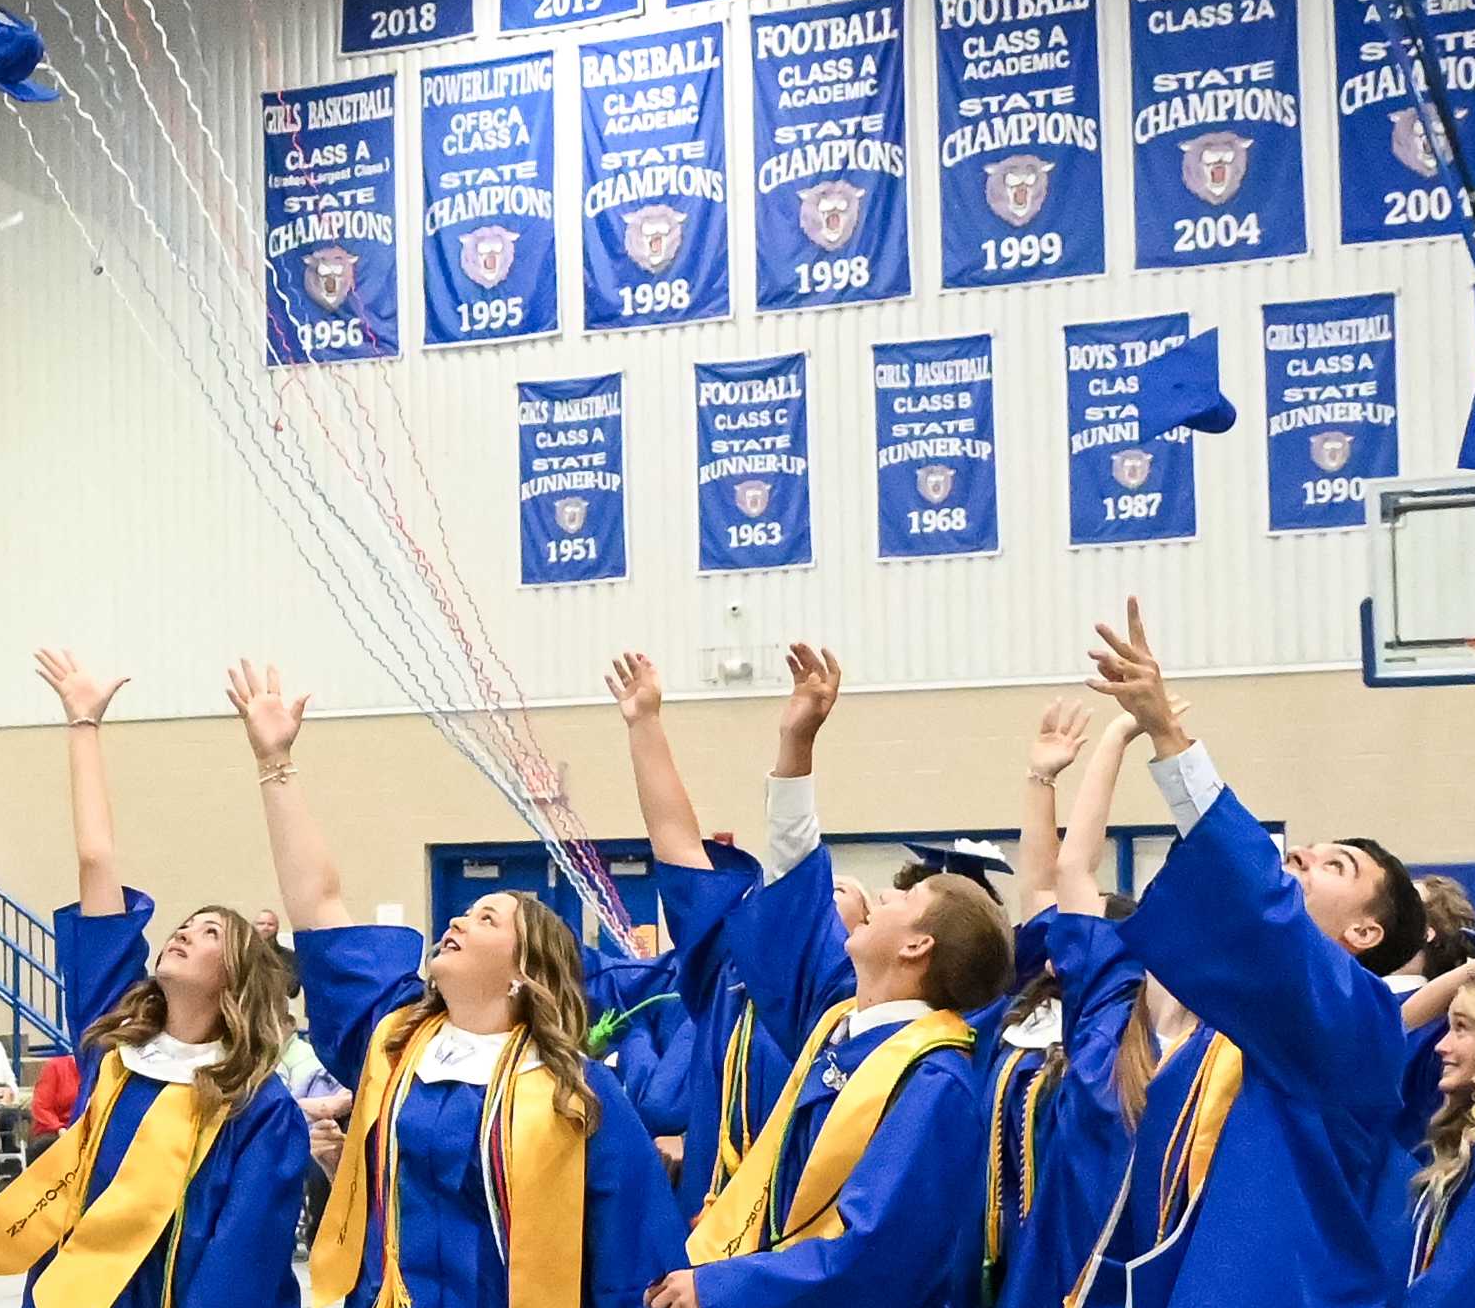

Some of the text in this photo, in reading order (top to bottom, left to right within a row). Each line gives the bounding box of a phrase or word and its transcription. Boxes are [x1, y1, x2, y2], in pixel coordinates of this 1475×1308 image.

[371, 2, 436, 39] 2018
[756, 7, 898, 59] FOOTBALL
[1148, 2, 1233, 34] CLASS
[962, 25, 1068, 59] CLASS A
[582, 36, 720, 88] BASEBALL
[778, 54, 877, 88] CLASS A
[963, 50, 1070, 81] ACADEMIC
[1153, 60, 1275, 93] STATE
[424, 57, 552, 108] POWERLIFTING
[778, 78, 878, 109] ACADEMIC
[264, 87, 393, 134] GIRLS BASKETBALL
[604, 83, 698, 116] CLASS A
[959, 84, 1076, 116] STATE
[451, 105, 524, 133] OFBCA
[603, 107, 699, 136] ACADEMIC
[774, 113, 884, 145] STATE
[1134, 88, 1297, 144] CHAMPIONS
[285, 140, 369, 171] CLASS A
[442, 125, 530, 156] CLASS A
[601, 140, 705, 170] STATE
[942, 112, 1098, 168] CHAMPIONS
[440, 161, 538, 189] STATE
[758, 139, 904, 193] CHAMPIONS
[283, 186, 375, 213] STATE
[584, 165, 724, 218] CHAMPIONS
[426, 185, 551, 237] CHAMPIONS
[269, 210, 392, 258] CHAMPIONS
[1174, 213, 1260, 253] 2004
[981, 232, 1063, 270] 1999
[795, 255, 869, 294] 1998
[619, 279, 690, 316] 1998
[457, 297, 523, 332] 1995
[1265, 315, 1392, 351] GIRLS BASKETBALL
[875, 356, 991, 389] GIRLS BASKETBALL
[1068, 343, 1118, 371] BOYS
[1286, 354, 1374, 377] CLASS A
[699, 375, 801, 408] FOOTBALL
[893, 393, 972, 416] CLASS B
[1283, 379, 1378, 402] STATE
[518, 392, 621, 426] GIRLS BASKETBALL
[714, 409, 788, 430] CLASS C
[1268, 403, 1397, 437] RUNNER-UP
[535, 429, 605, 449] CLASS A
[891, 418, 975, 438] STATE
[711, 436, 791, 454] STATE
[877, 439, 992, 469] RUNNER-UP
[532, 453, 607, 471] STATE
[699, 455, 807, 485] RUNNER-UP
[521, 471, 621, 502] RUNNER-UP
[907, 508, 967, 534] 1968
[1102, 492, 1162, 521] 1987
[546, 537, 597, 564] 1951
[727, 522, 782, 548] 1963
